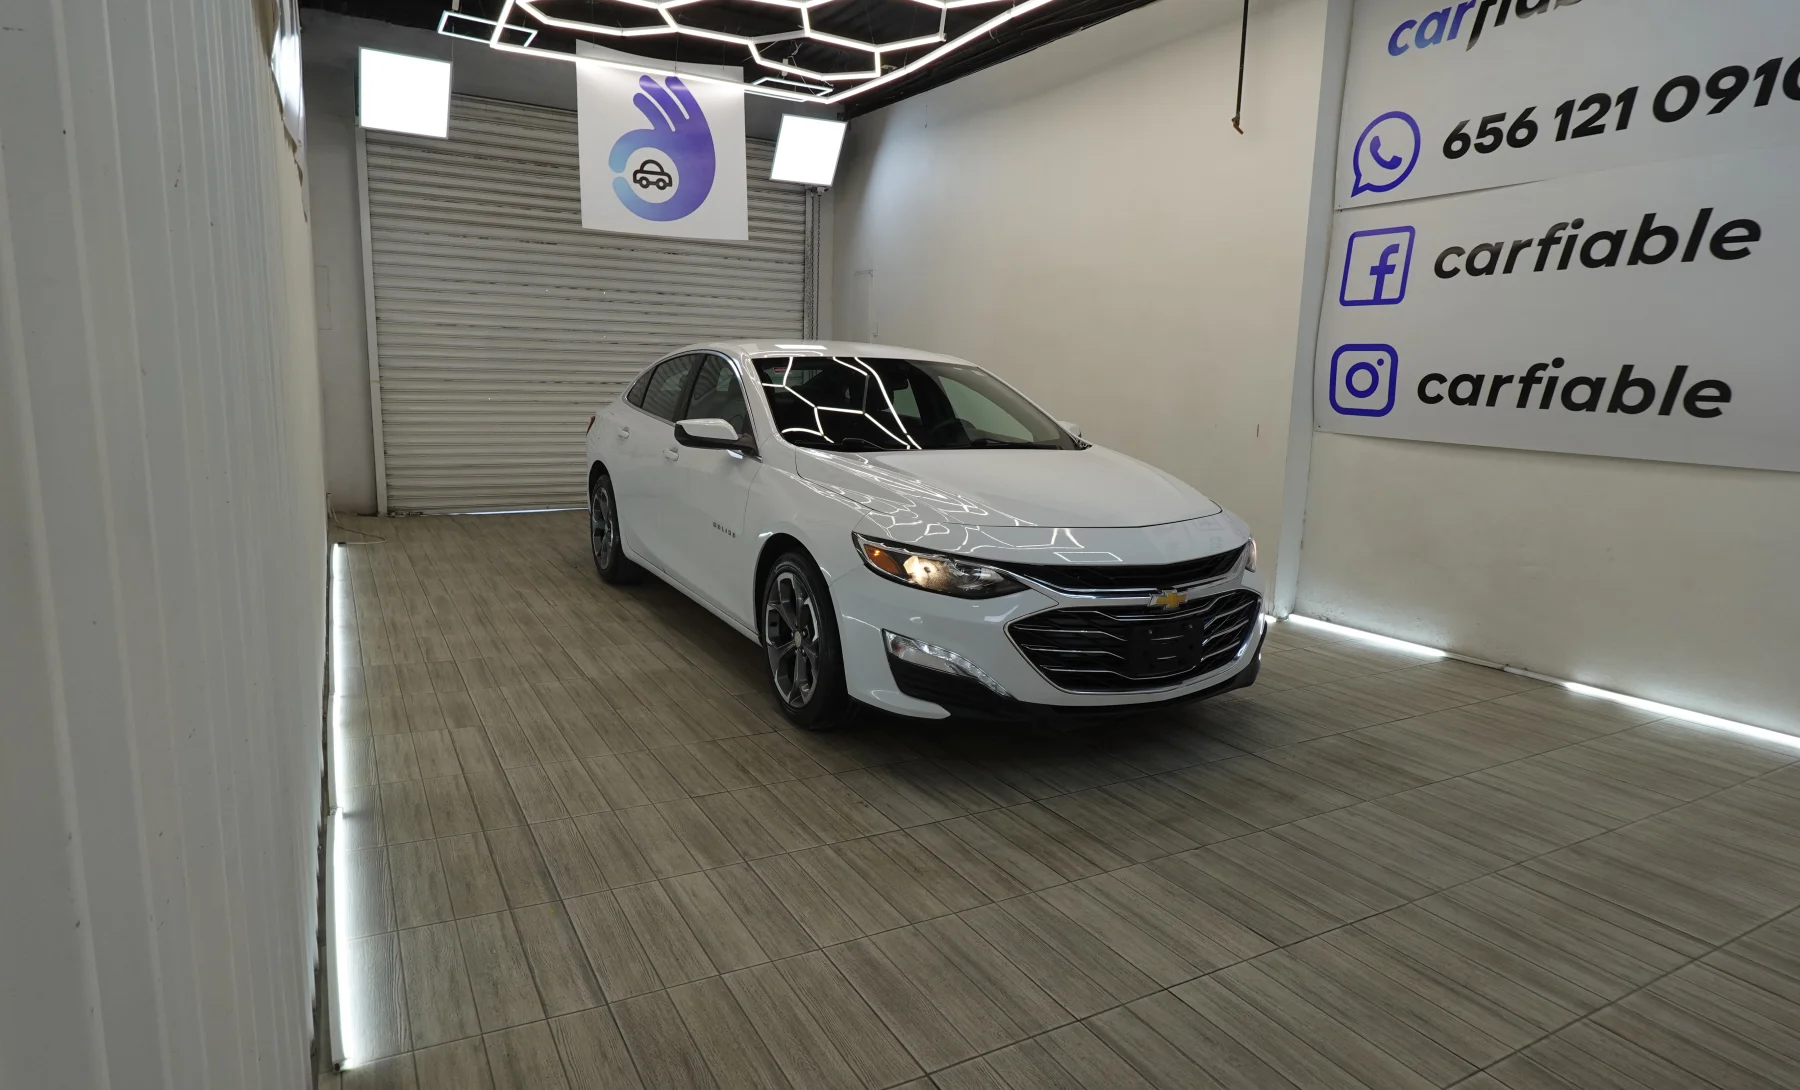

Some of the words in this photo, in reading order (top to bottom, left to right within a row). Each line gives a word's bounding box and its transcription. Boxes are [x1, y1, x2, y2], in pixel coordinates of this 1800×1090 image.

[1443, 106, 1538, 159] 656
[1554, 86, 1638, 142] 121
[1434, 208, 1761, 279] carfiable
[1417, 357, 1732, 418] carfiable
